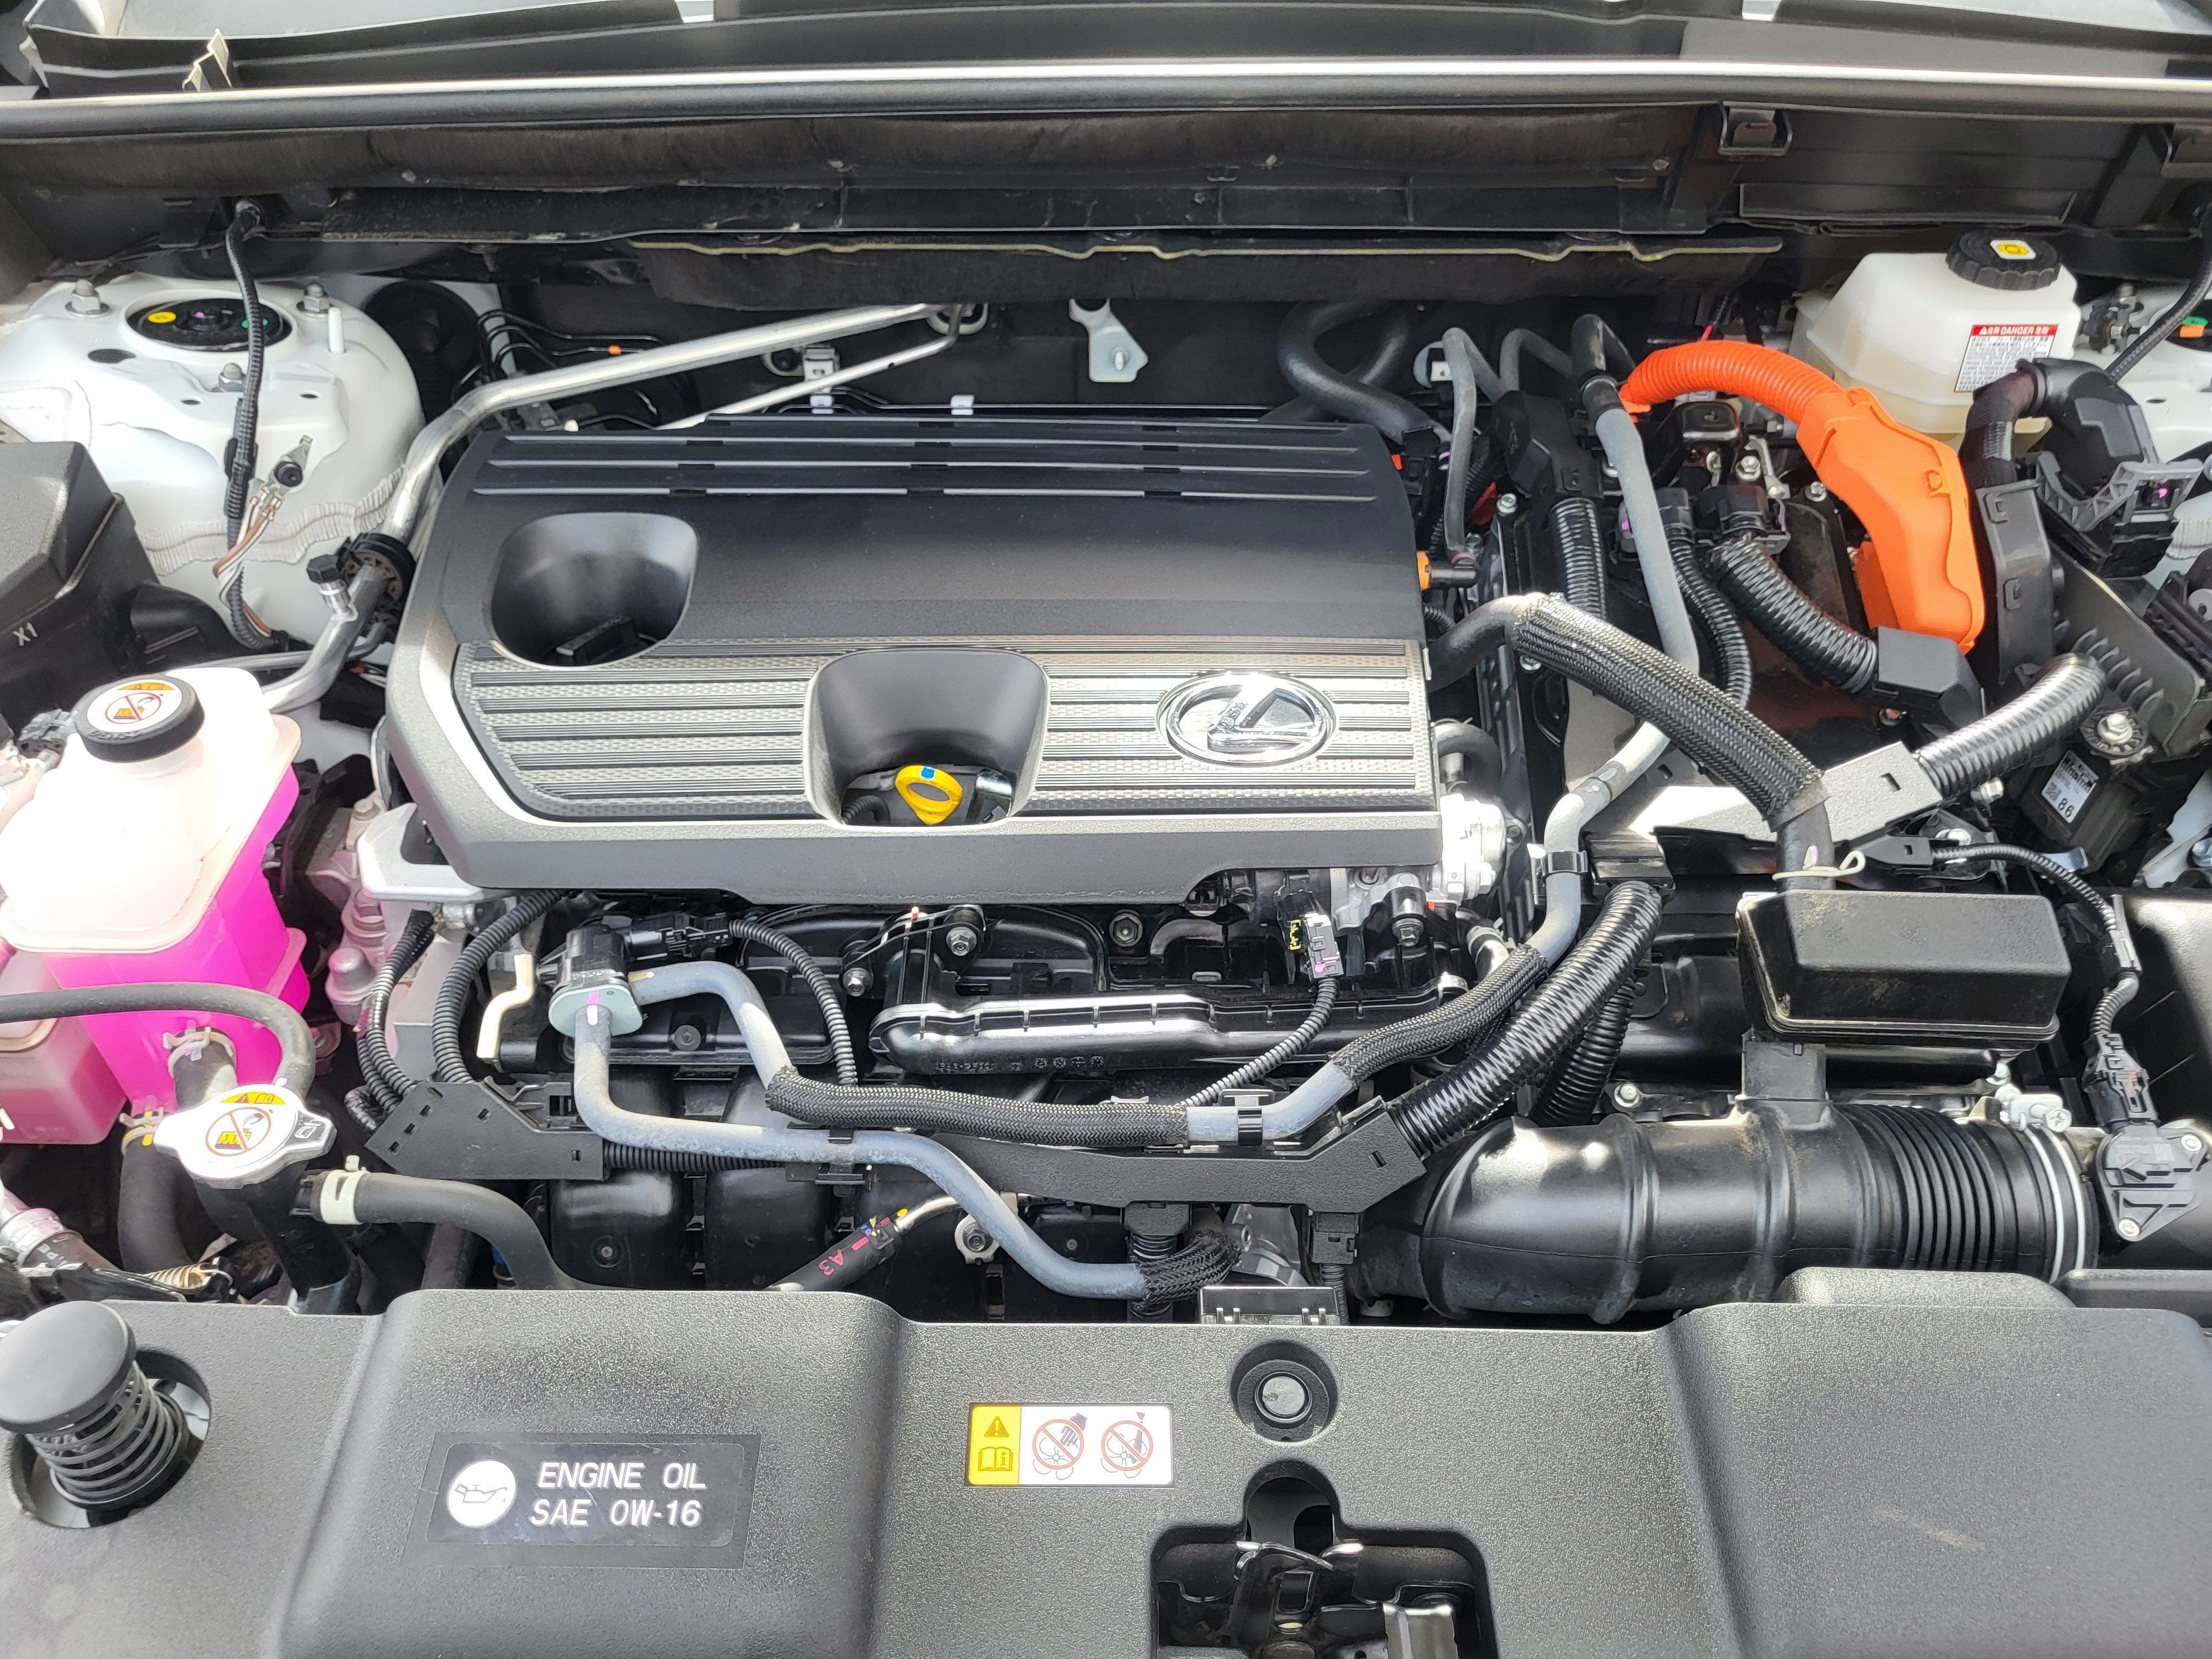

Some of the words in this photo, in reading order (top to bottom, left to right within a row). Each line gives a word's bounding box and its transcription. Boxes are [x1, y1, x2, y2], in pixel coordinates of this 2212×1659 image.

[2000, 326, 2034, 335] DANGER
[2058, 797, 2075, 818] 86
[819, 1249, 843, 1276] A3
[538, 1462, 644, 1488] ENGINE
[664, 1463, 706, 1488] OIL
[530, 1499, 592, 1525] SAE
[611, 1499, 701, 1526] 0W-16
